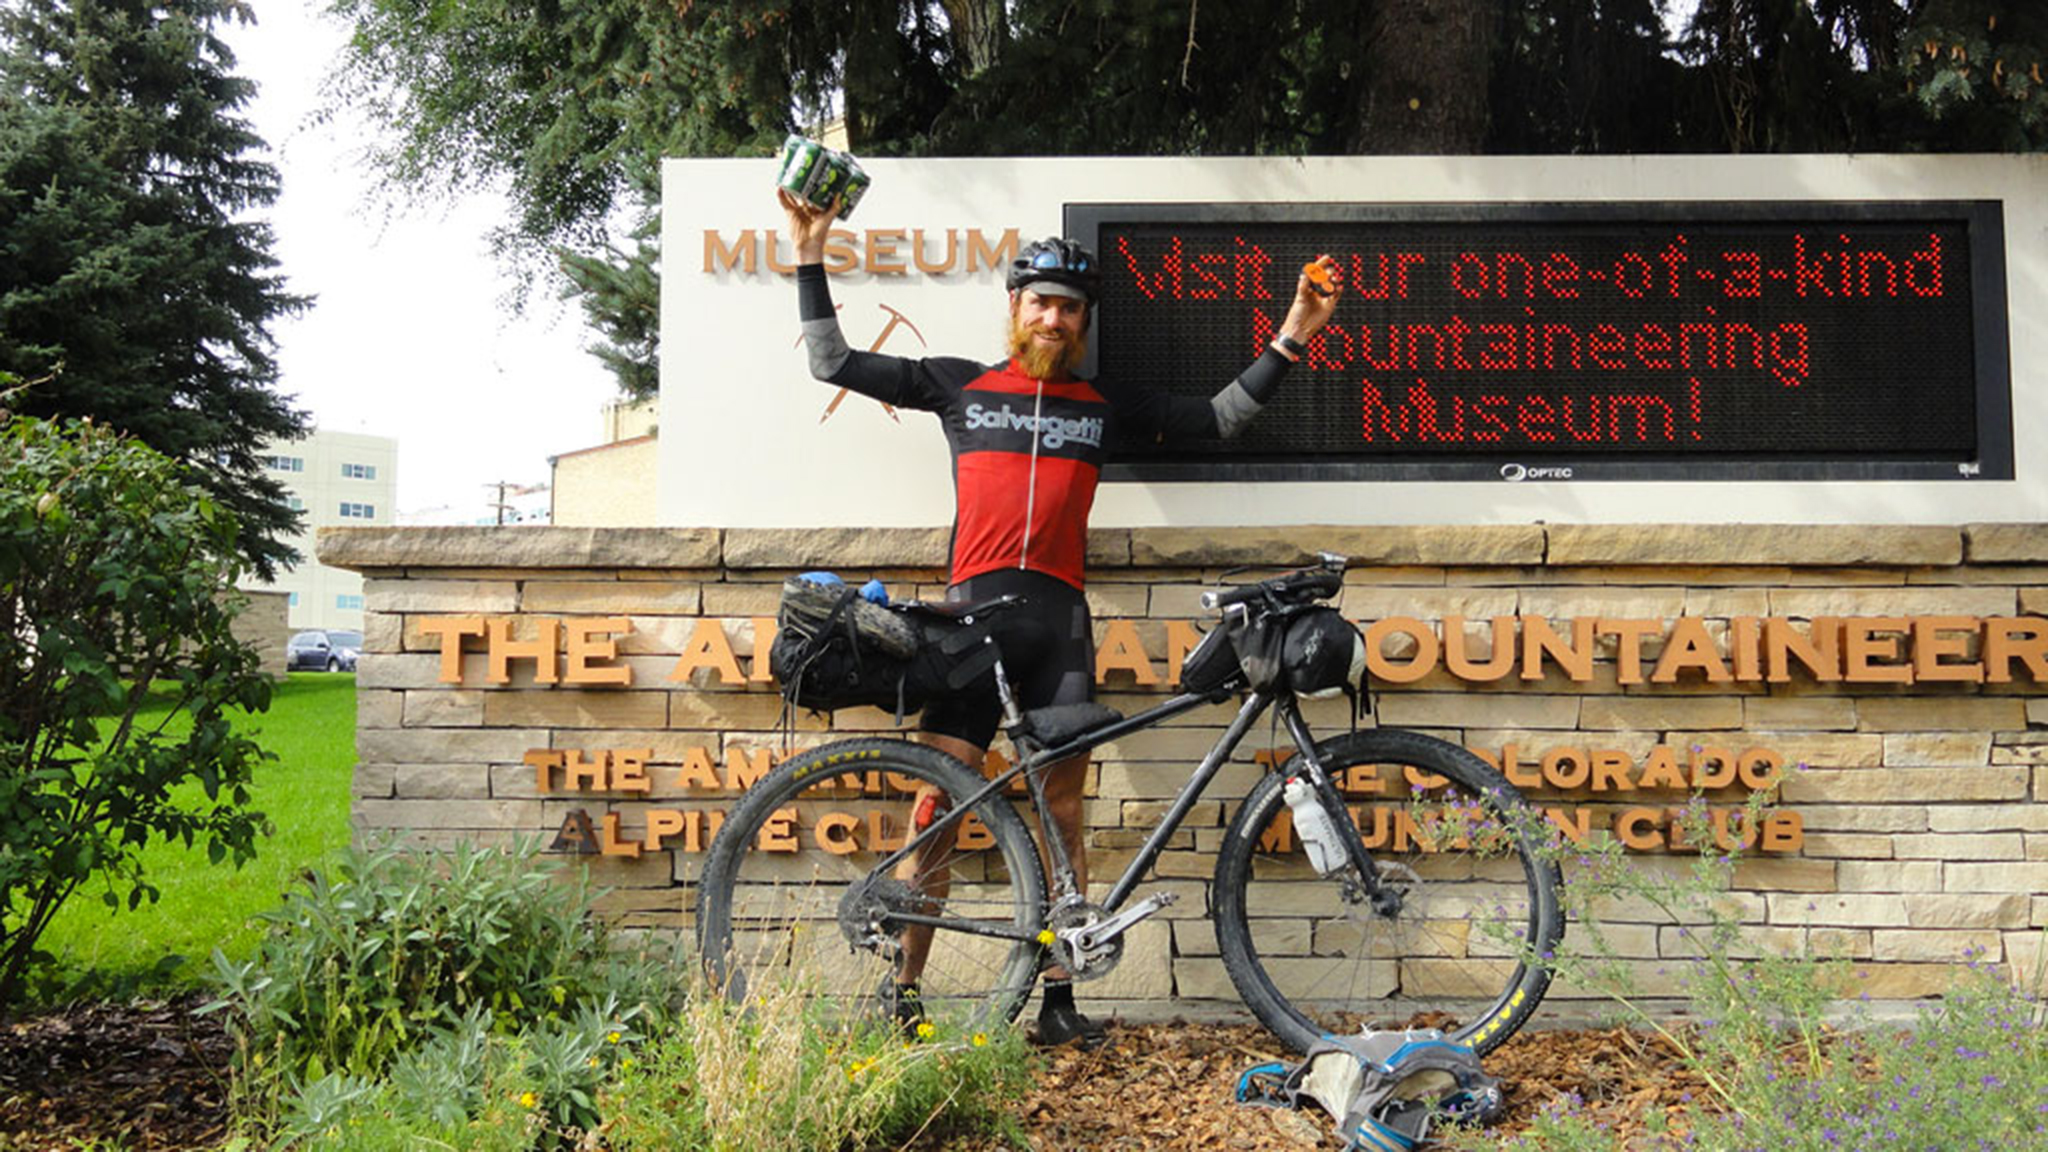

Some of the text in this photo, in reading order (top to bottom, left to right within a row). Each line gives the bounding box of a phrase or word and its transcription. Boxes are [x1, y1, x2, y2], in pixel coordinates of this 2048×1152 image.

[1117, 235, 1272, 300] Visit
[1451, 233, 1943, 300] one-of-a-kind
[965, 403, 1104, 449] Salvagetti
[1361, 376, 1702, 442] Museum!
[1527, 466, 1573, 479] OPTEC
[418, 616, 638, 686] THE
[1348, 614, 2048, 686] OUNTAINEER
[523, 747, 656, 793] THE
[793, 749, 881, 780] MAXXIS
[815, 809, 997, 857] CLB
[1464, 987, 1525, 1046] MAXX
